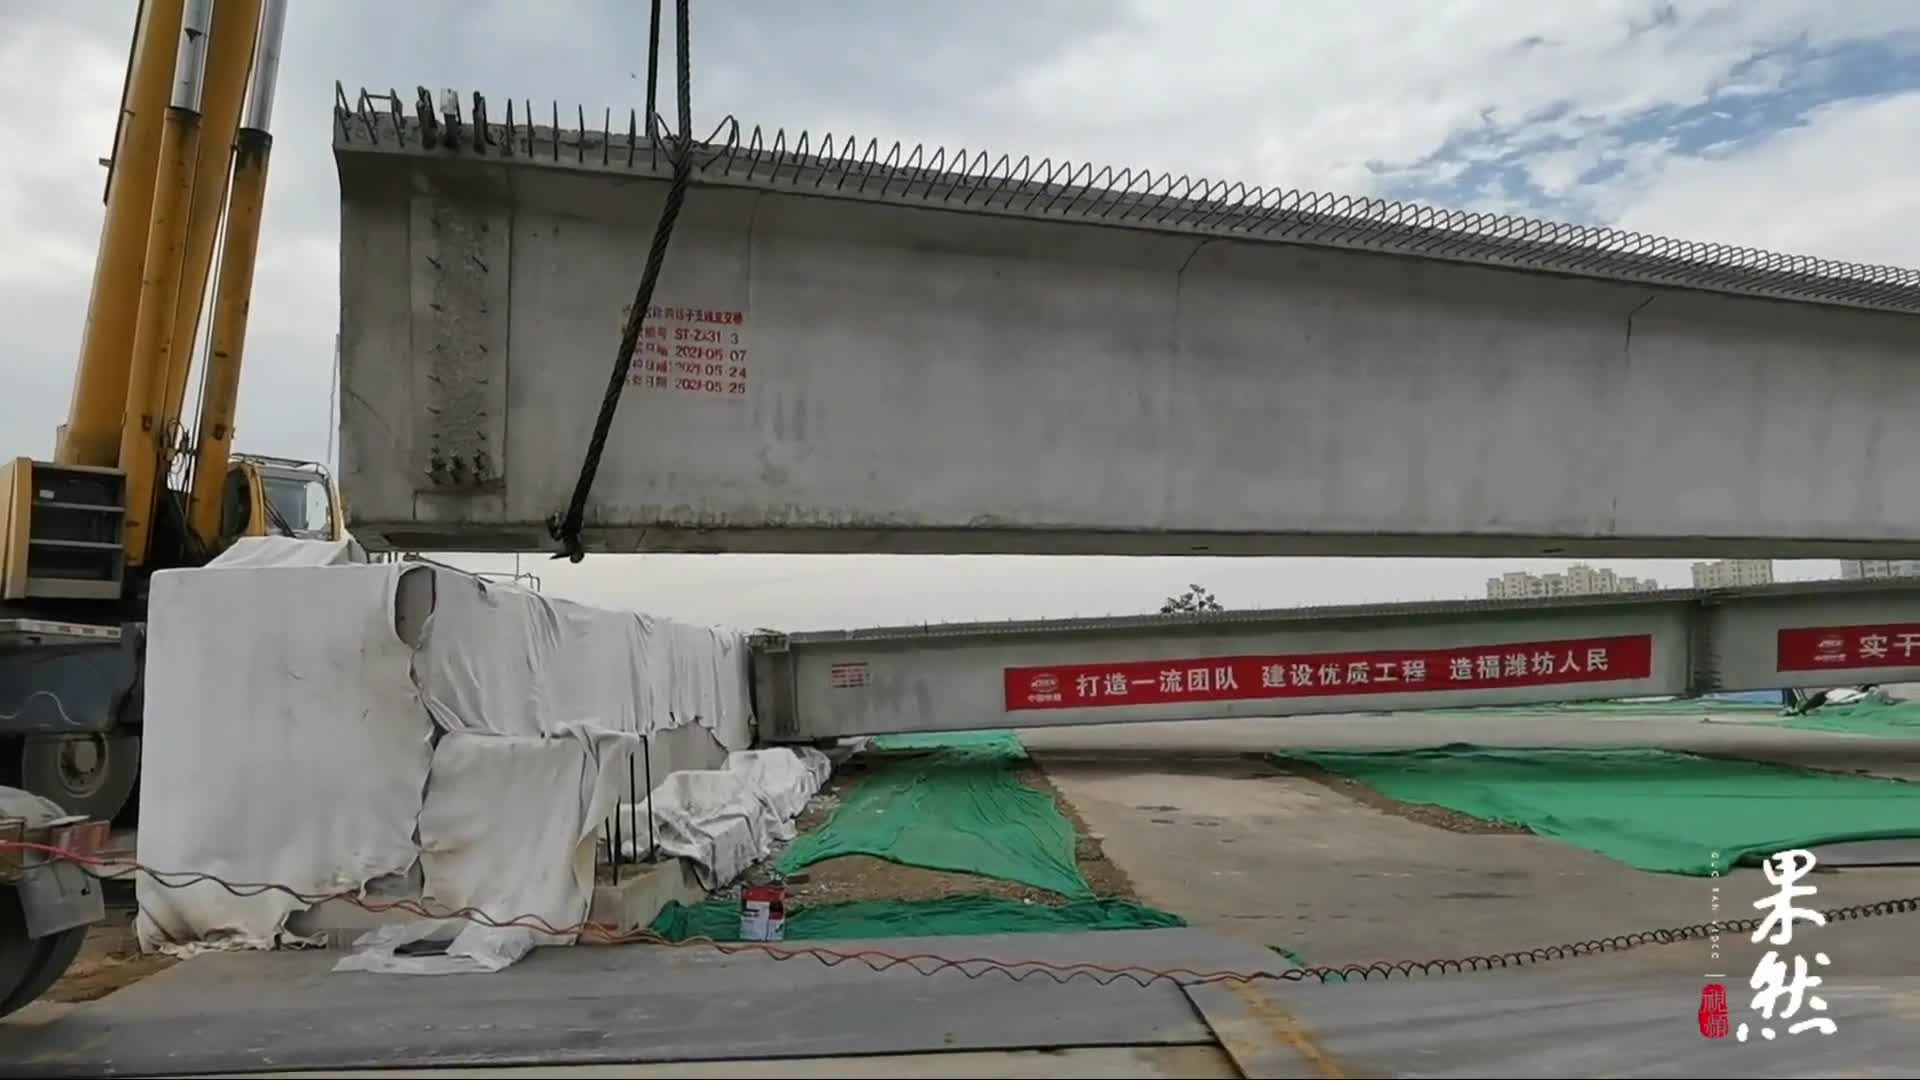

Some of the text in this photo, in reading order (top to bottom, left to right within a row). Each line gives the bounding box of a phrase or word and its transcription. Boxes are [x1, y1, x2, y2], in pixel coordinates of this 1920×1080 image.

[1076, 648, 1609, 697] 打造一流团队 建设优质工程 造福潍坊人民
